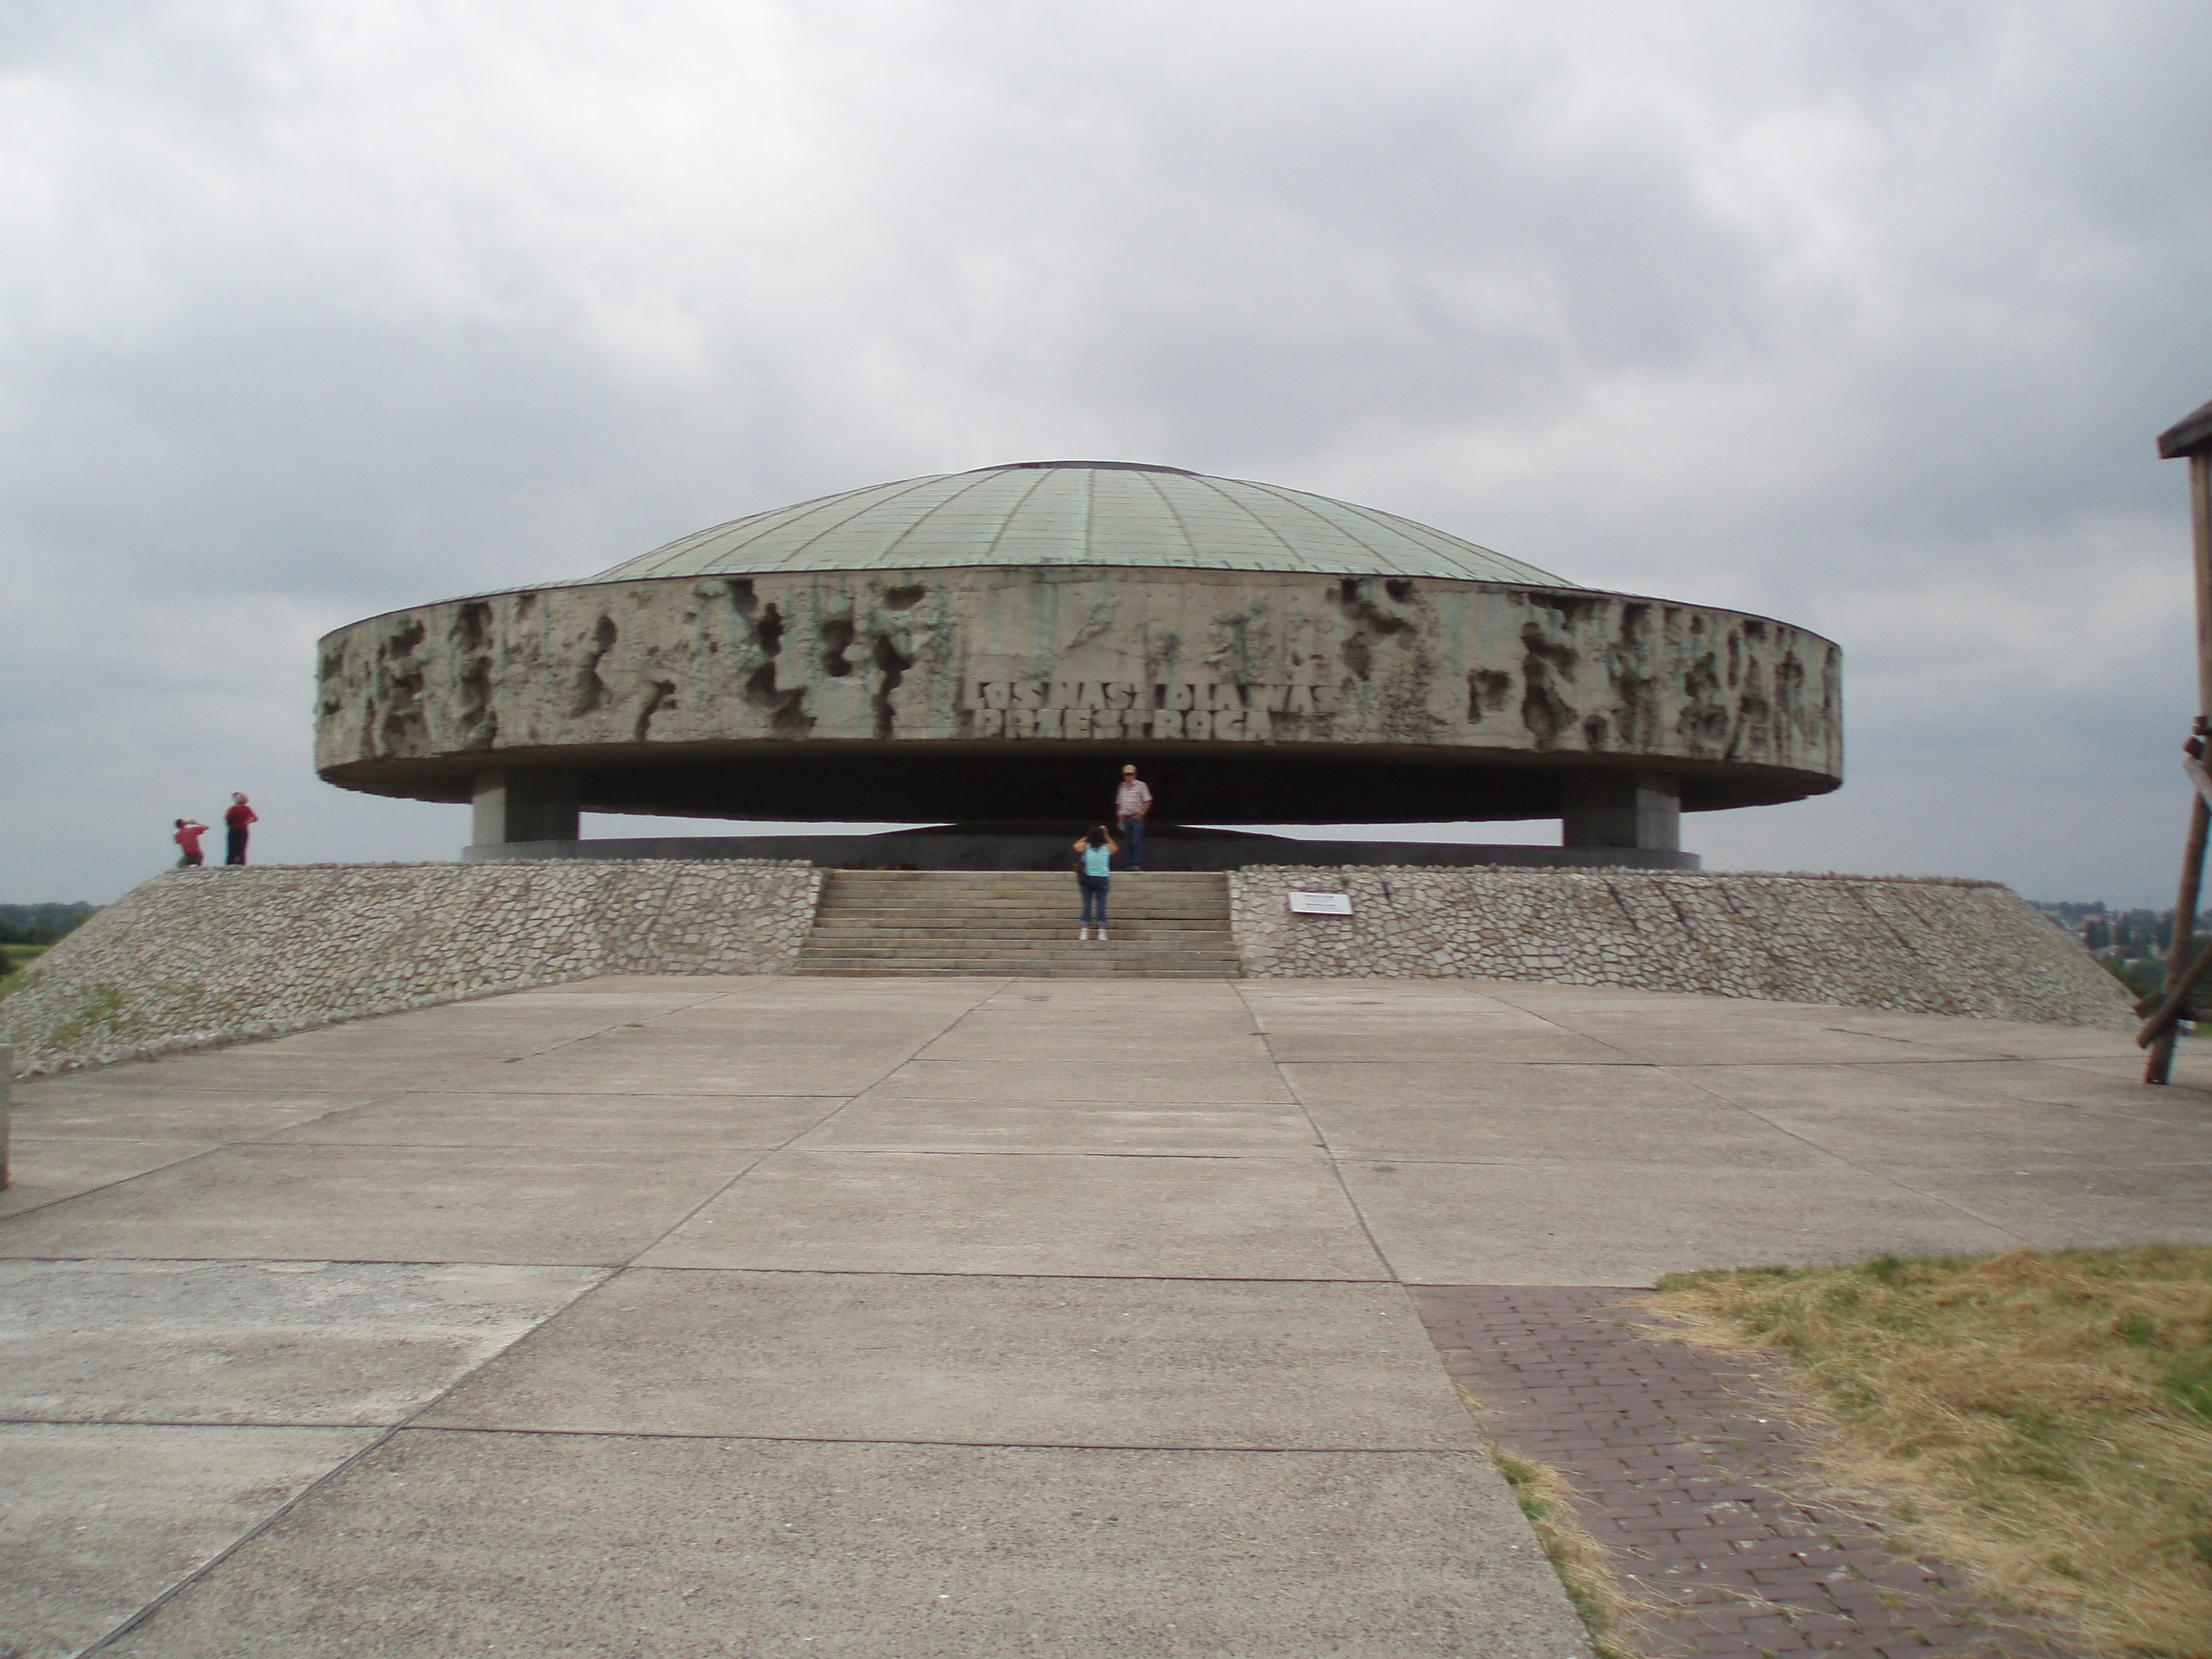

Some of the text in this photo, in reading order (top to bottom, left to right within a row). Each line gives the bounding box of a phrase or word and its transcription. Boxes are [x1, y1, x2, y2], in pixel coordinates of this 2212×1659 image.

[963, 681, 1041, 709] LOS
[1166, 683, 1246, 710] DLA
[1247, 684, 1342, 712] WAS
